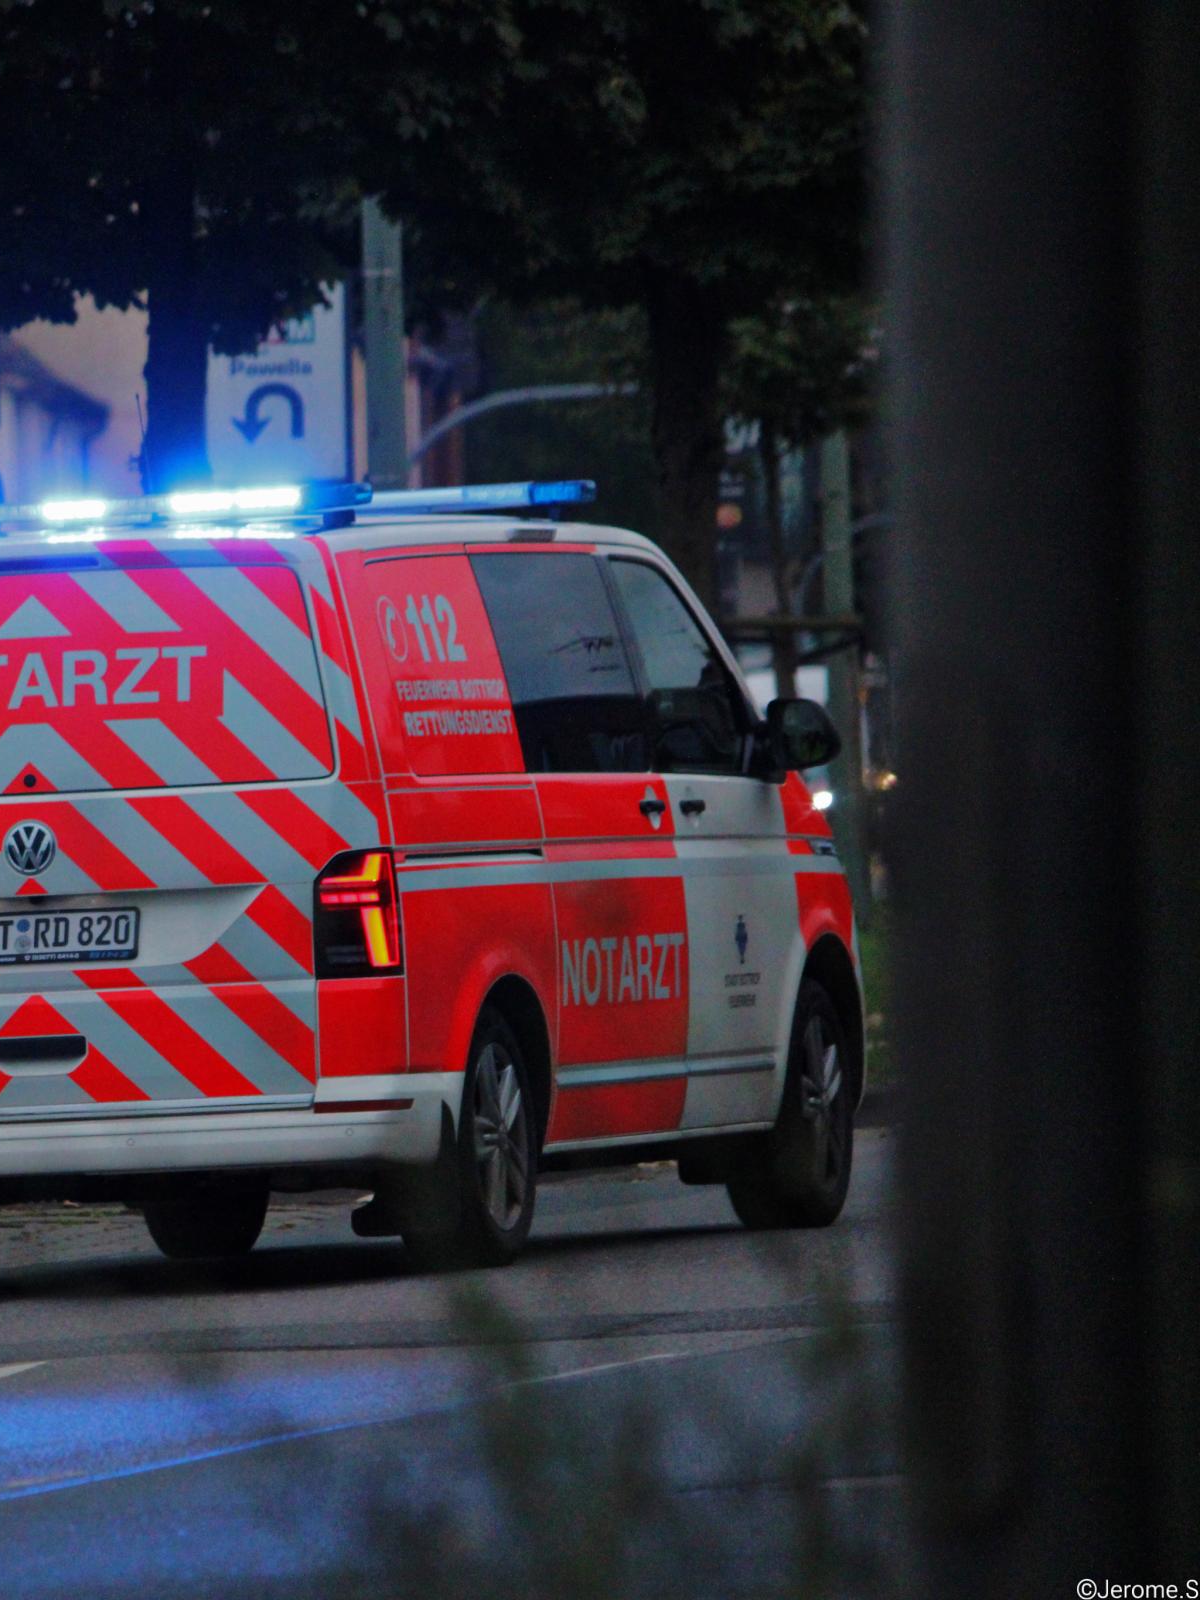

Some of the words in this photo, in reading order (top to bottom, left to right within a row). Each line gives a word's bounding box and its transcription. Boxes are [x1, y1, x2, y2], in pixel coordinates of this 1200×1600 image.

[405, 593, 468, 662] 112
[396, 679, 460, 701] FEUERWEHR
[403, 709, 513, 737] RETTUNGSDIENST
[33, 916, 70, 948] RD
[78, 914, 131, 947] 820
[561, 932, 684, 1007] NOTARZT
